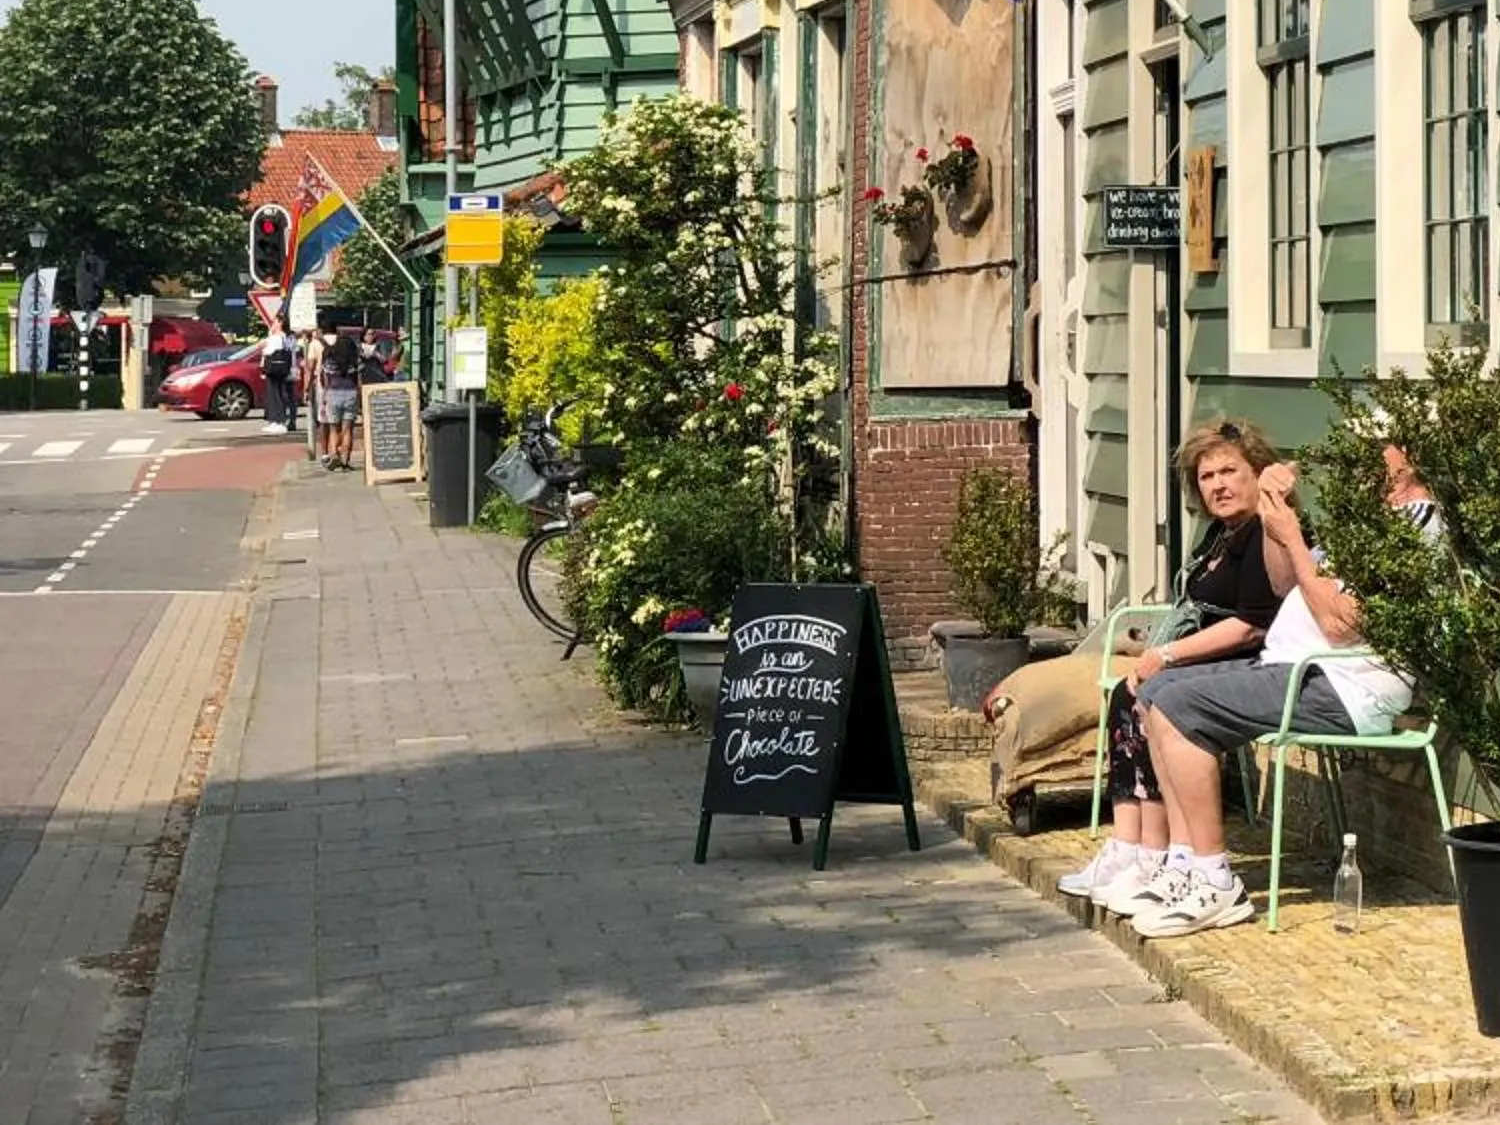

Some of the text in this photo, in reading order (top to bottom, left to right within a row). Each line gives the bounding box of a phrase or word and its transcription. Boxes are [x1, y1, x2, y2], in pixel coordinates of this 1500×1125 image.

[733, 620, 841, 654] HAPPINESS
[760, 649, 806, 668] is an
[729, 676, 834, 703] UNEXPECTED
[746, 706, 785, 726] piece
[724, 726, 821, 765] Chocolate
